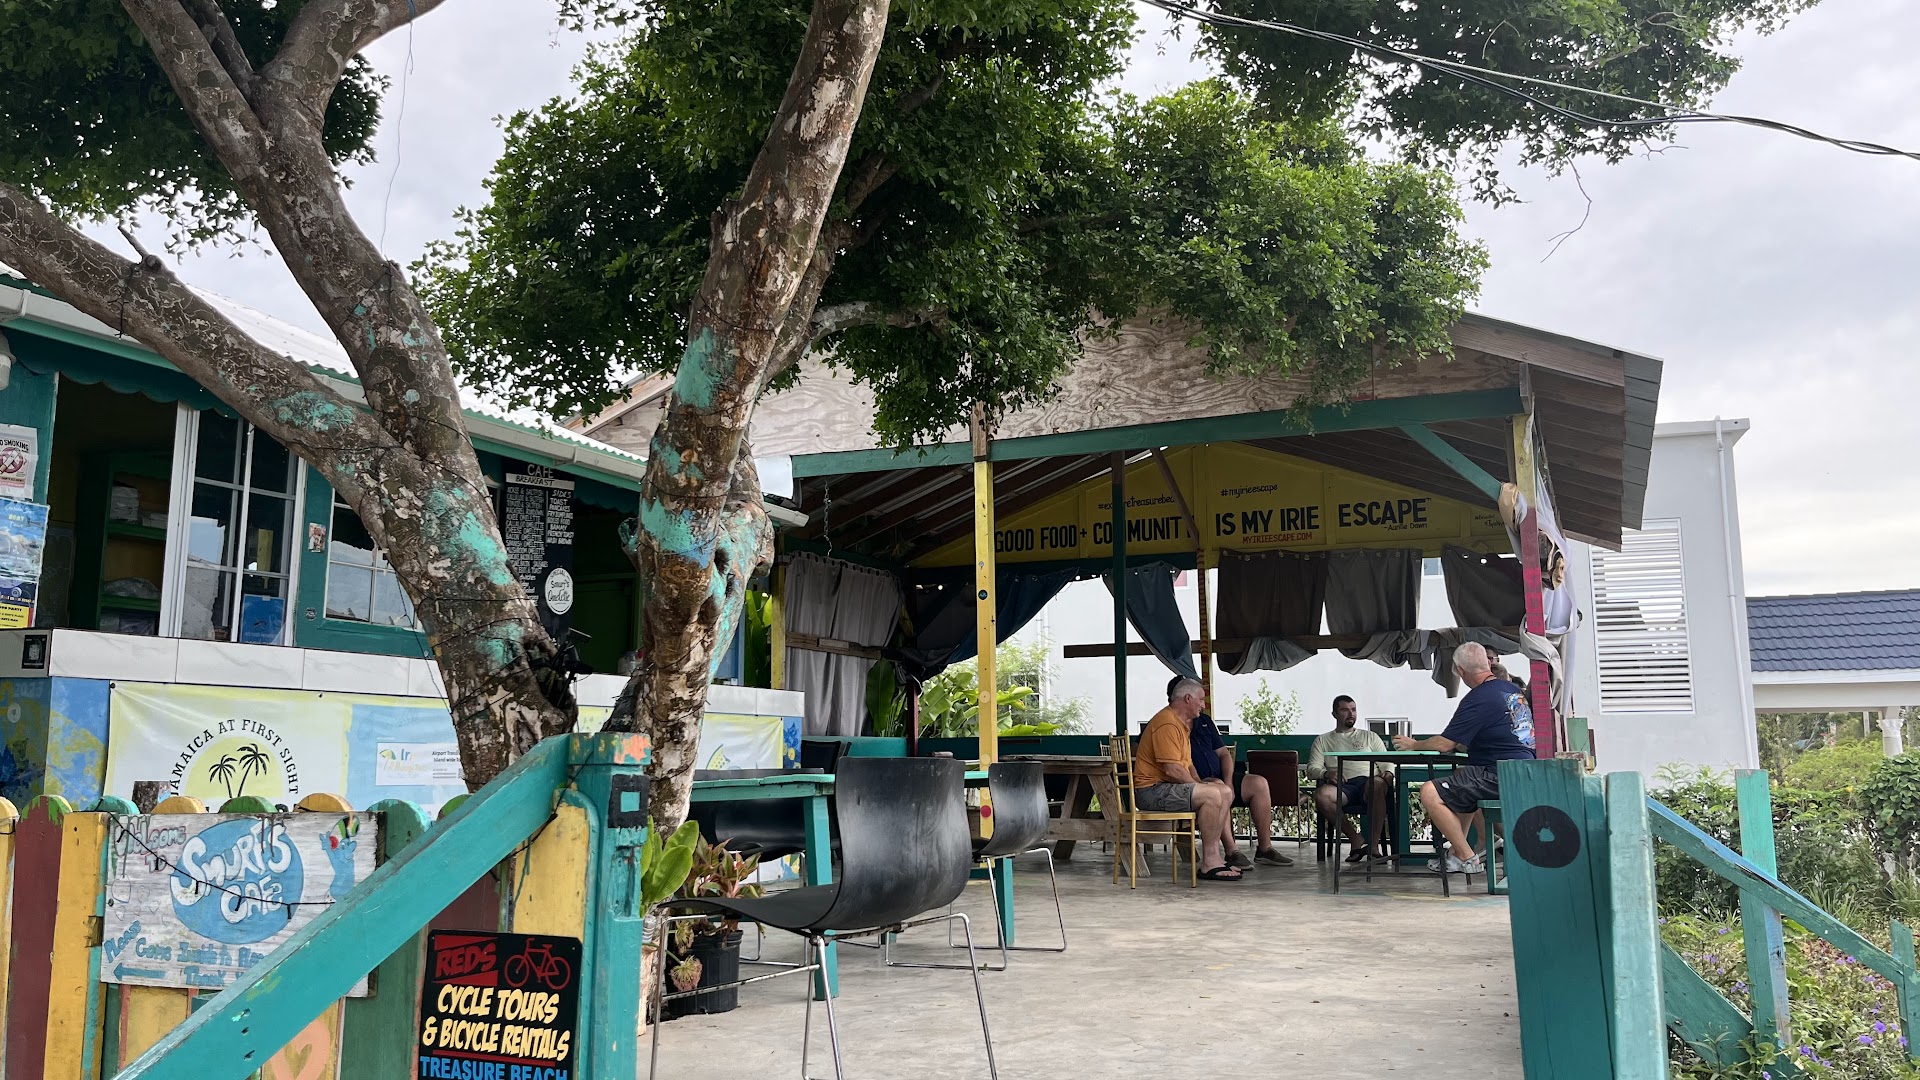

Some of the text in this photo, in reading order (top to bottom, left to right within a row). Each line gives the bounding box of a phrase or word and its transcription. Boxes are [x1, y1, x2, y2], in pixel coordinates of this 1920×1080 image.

[4, 440, 29, 452] SMOKING
[527, 464, 554, 479] CAFE
[516, 475, 555, 486] BREAKFAST
[552, 489, 572, 499] SIDES
[1220, 483, 1278, 498] #myirieescape
[550, 497, 568, 506] TOAST
[994, 528, 1034, 553] GOOD
[1040, 524, 1077, 549] FOOD
[1093, 515, 1195, 545] COMUNIT
[1215, 512, 1236, 537] IS
[1241, 510, 1274, 535] MY
[1280, 506, 1320, 532] IRIE
[1338, 498, 1428, 528] ESCAPE
[1242, 532, 1312, 544] MYIRIEESCAPE.COM
[170, 719, 299, 796] JAMAICA AT FIRST SIGHT
[435, 942, 497, 978] REDS
[437, 984, 560, 1024] CYCLE TOURS
[422, 1016, 571, 1062] & BICYCLE RENTALS
[420, 1056, 568, 1080] TREASURE BEACH
